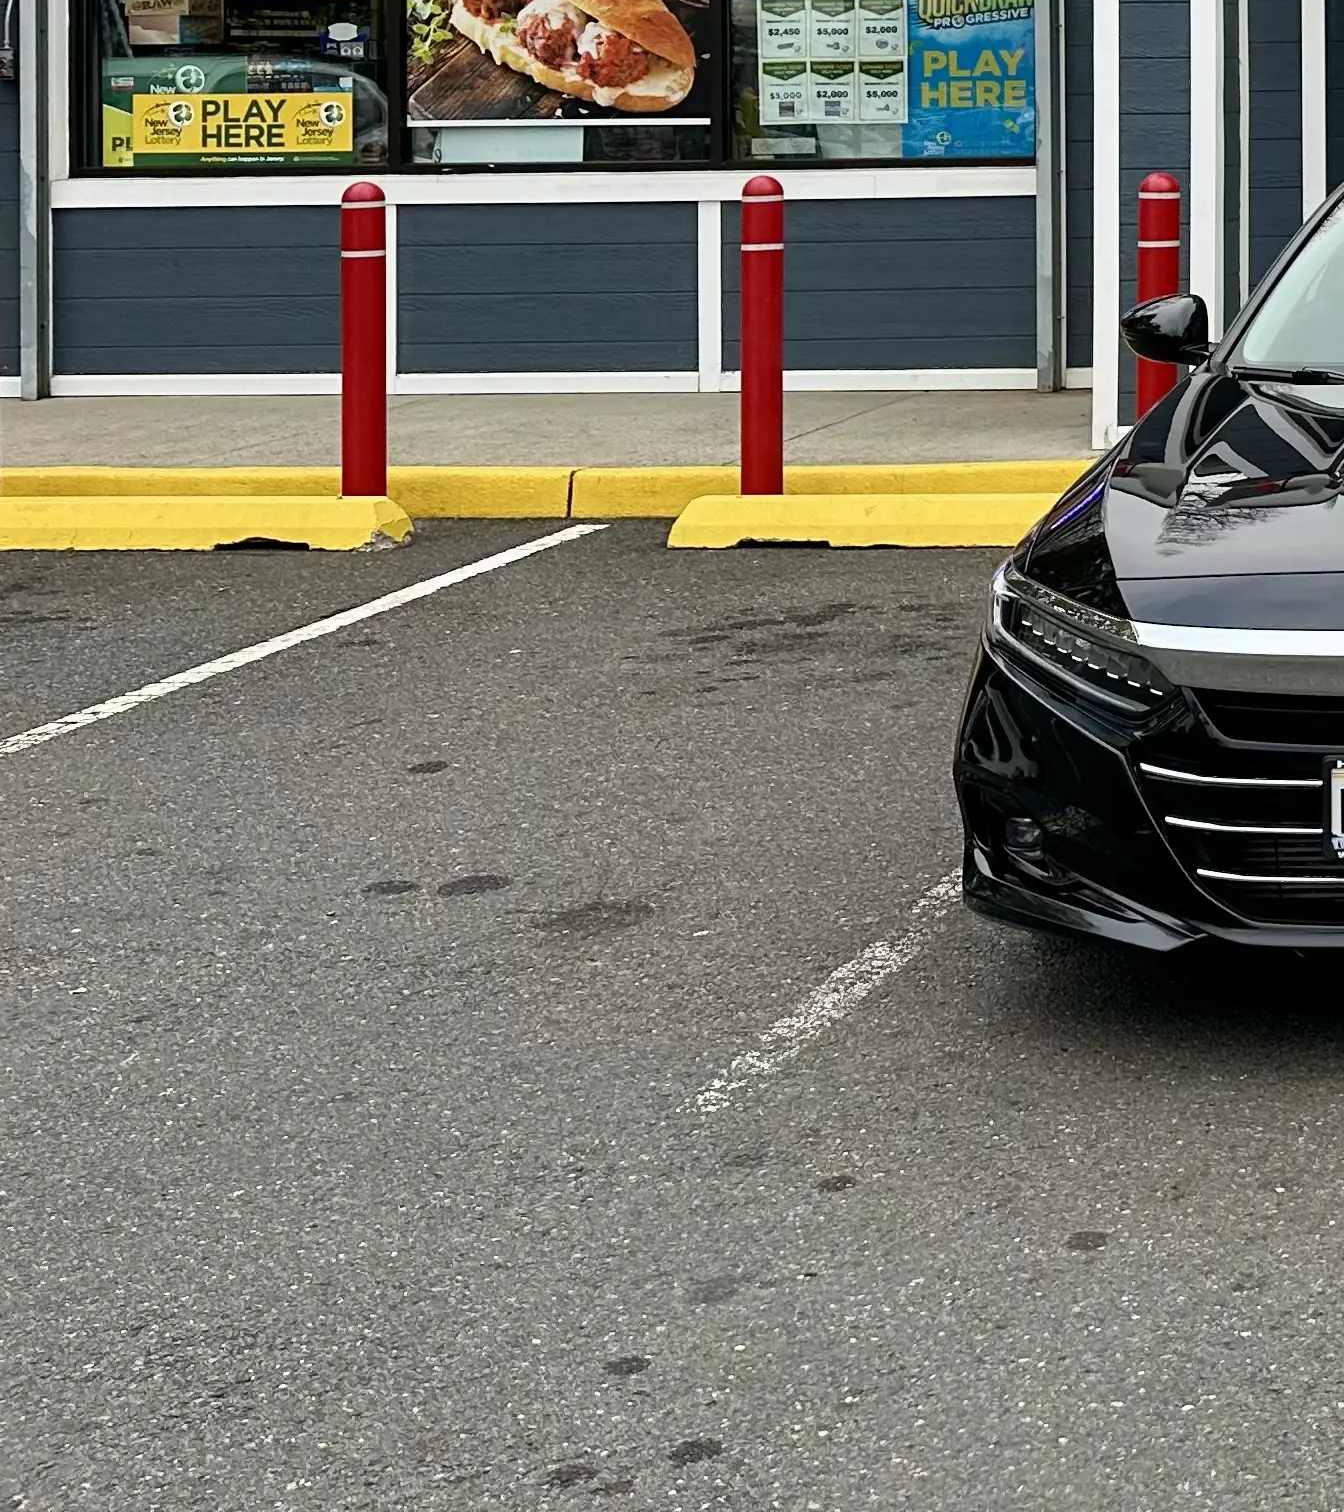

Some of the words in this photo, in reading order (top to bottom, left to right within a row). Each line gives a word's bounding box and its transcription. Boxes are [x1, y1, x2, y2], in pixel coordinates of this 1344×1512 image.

[923, 50, 1024, 77] PLAY
[150, 84, 176, 94] New
[920, 80, 1026, 107] HERE
[201, 99, 287, 123] PLAY
[144, 118, 168, 127] New
[296, 118, 320, 127] New
[149, 127, 182, 137] Jersey
[201, 124, 285, 148] HERE
[301, 127, 334, 137] Jersey
[144, 136, 181, 146] Lottery
[296, 136, 333, 146] Lottery
